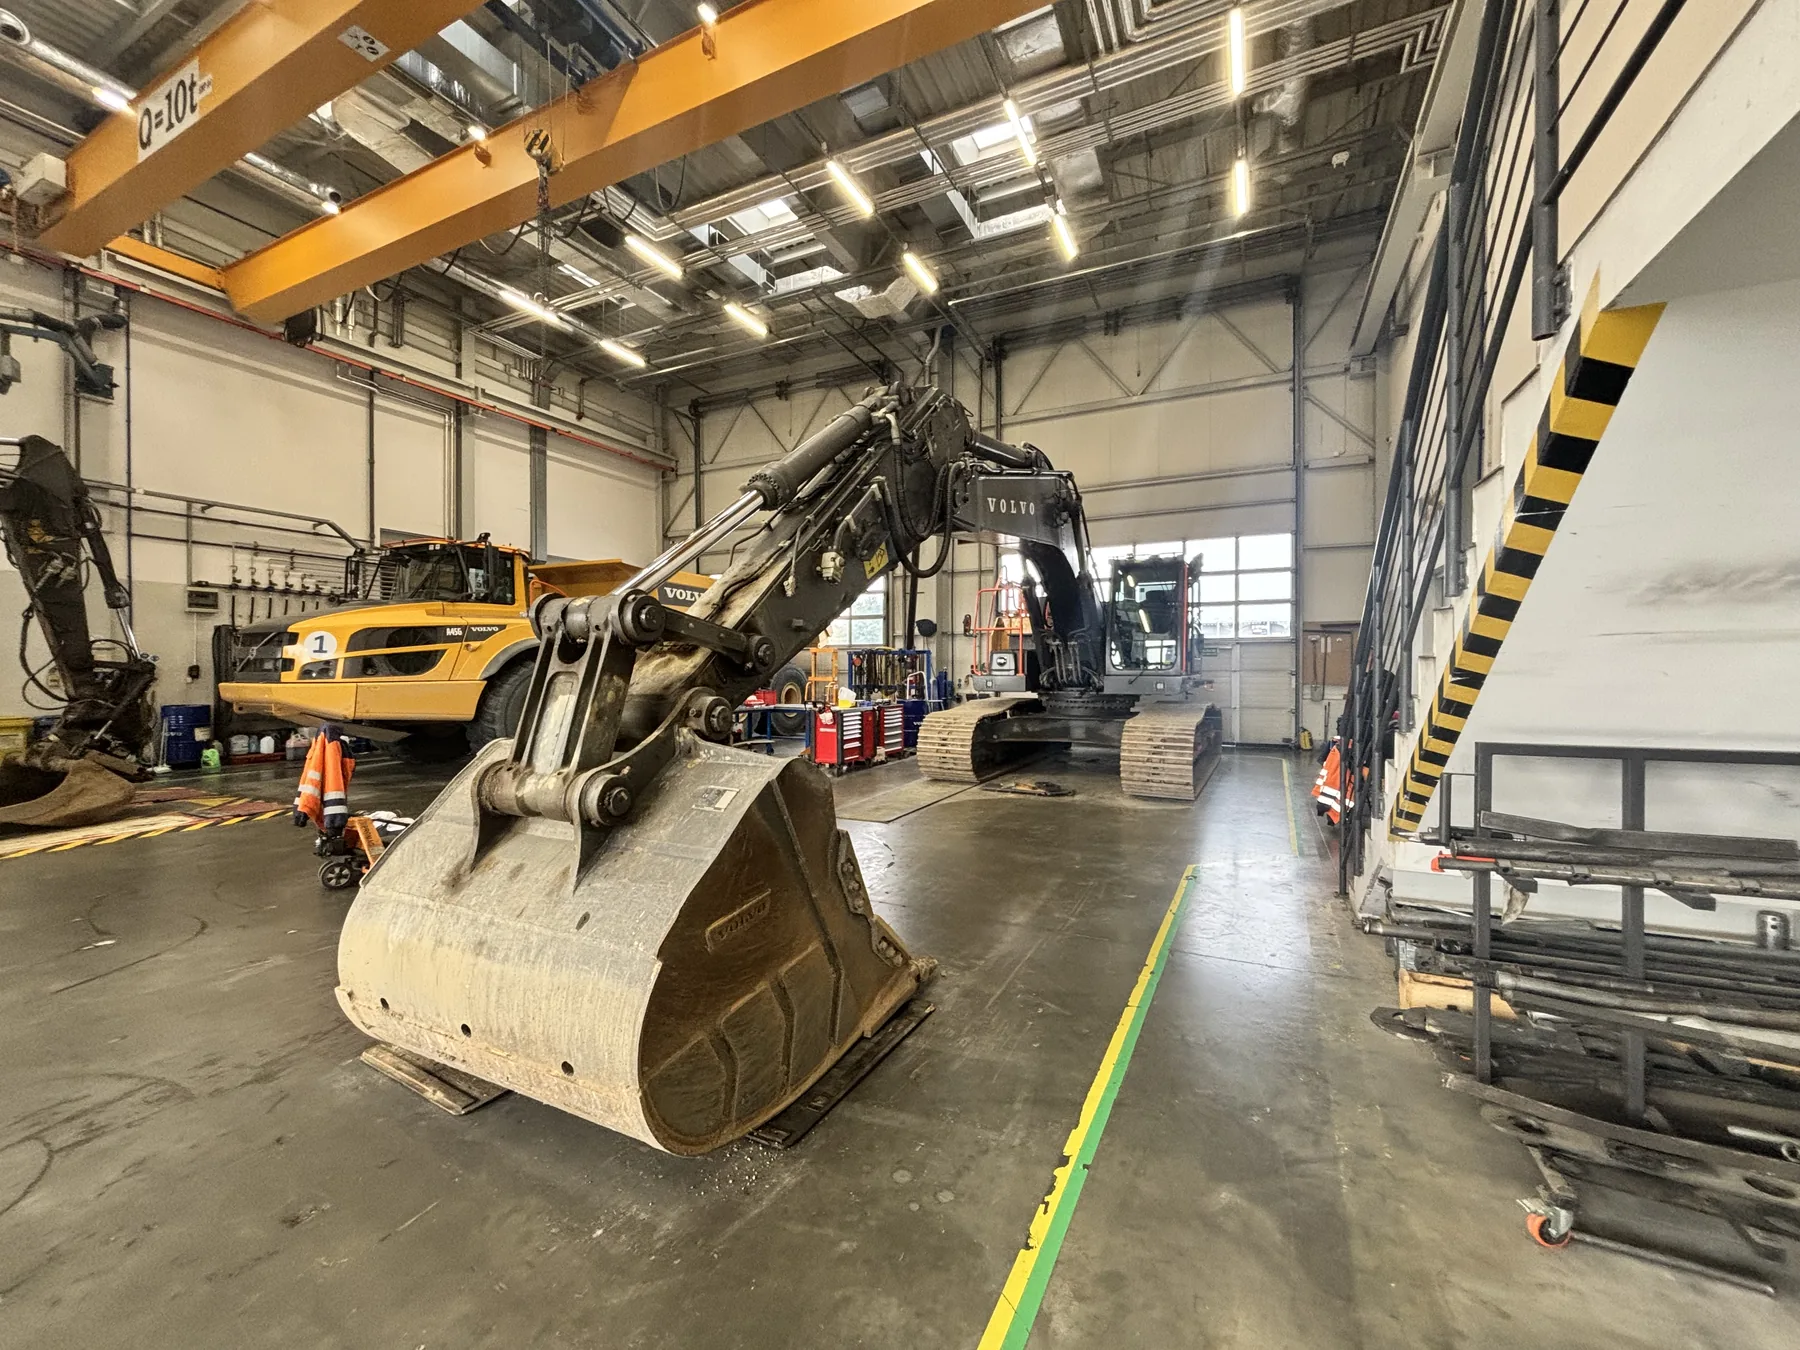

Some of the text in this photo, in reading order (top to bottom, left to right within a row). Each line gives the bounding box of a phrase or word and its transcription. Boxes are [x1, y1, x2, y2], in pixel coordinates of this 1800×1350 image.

[140, 73, 197, 150] Q=10t
[987, 497, 1035, 516] VOLVO
[663, 586, 704, 601] VOLV
[312, 635, 328, 654] 1
